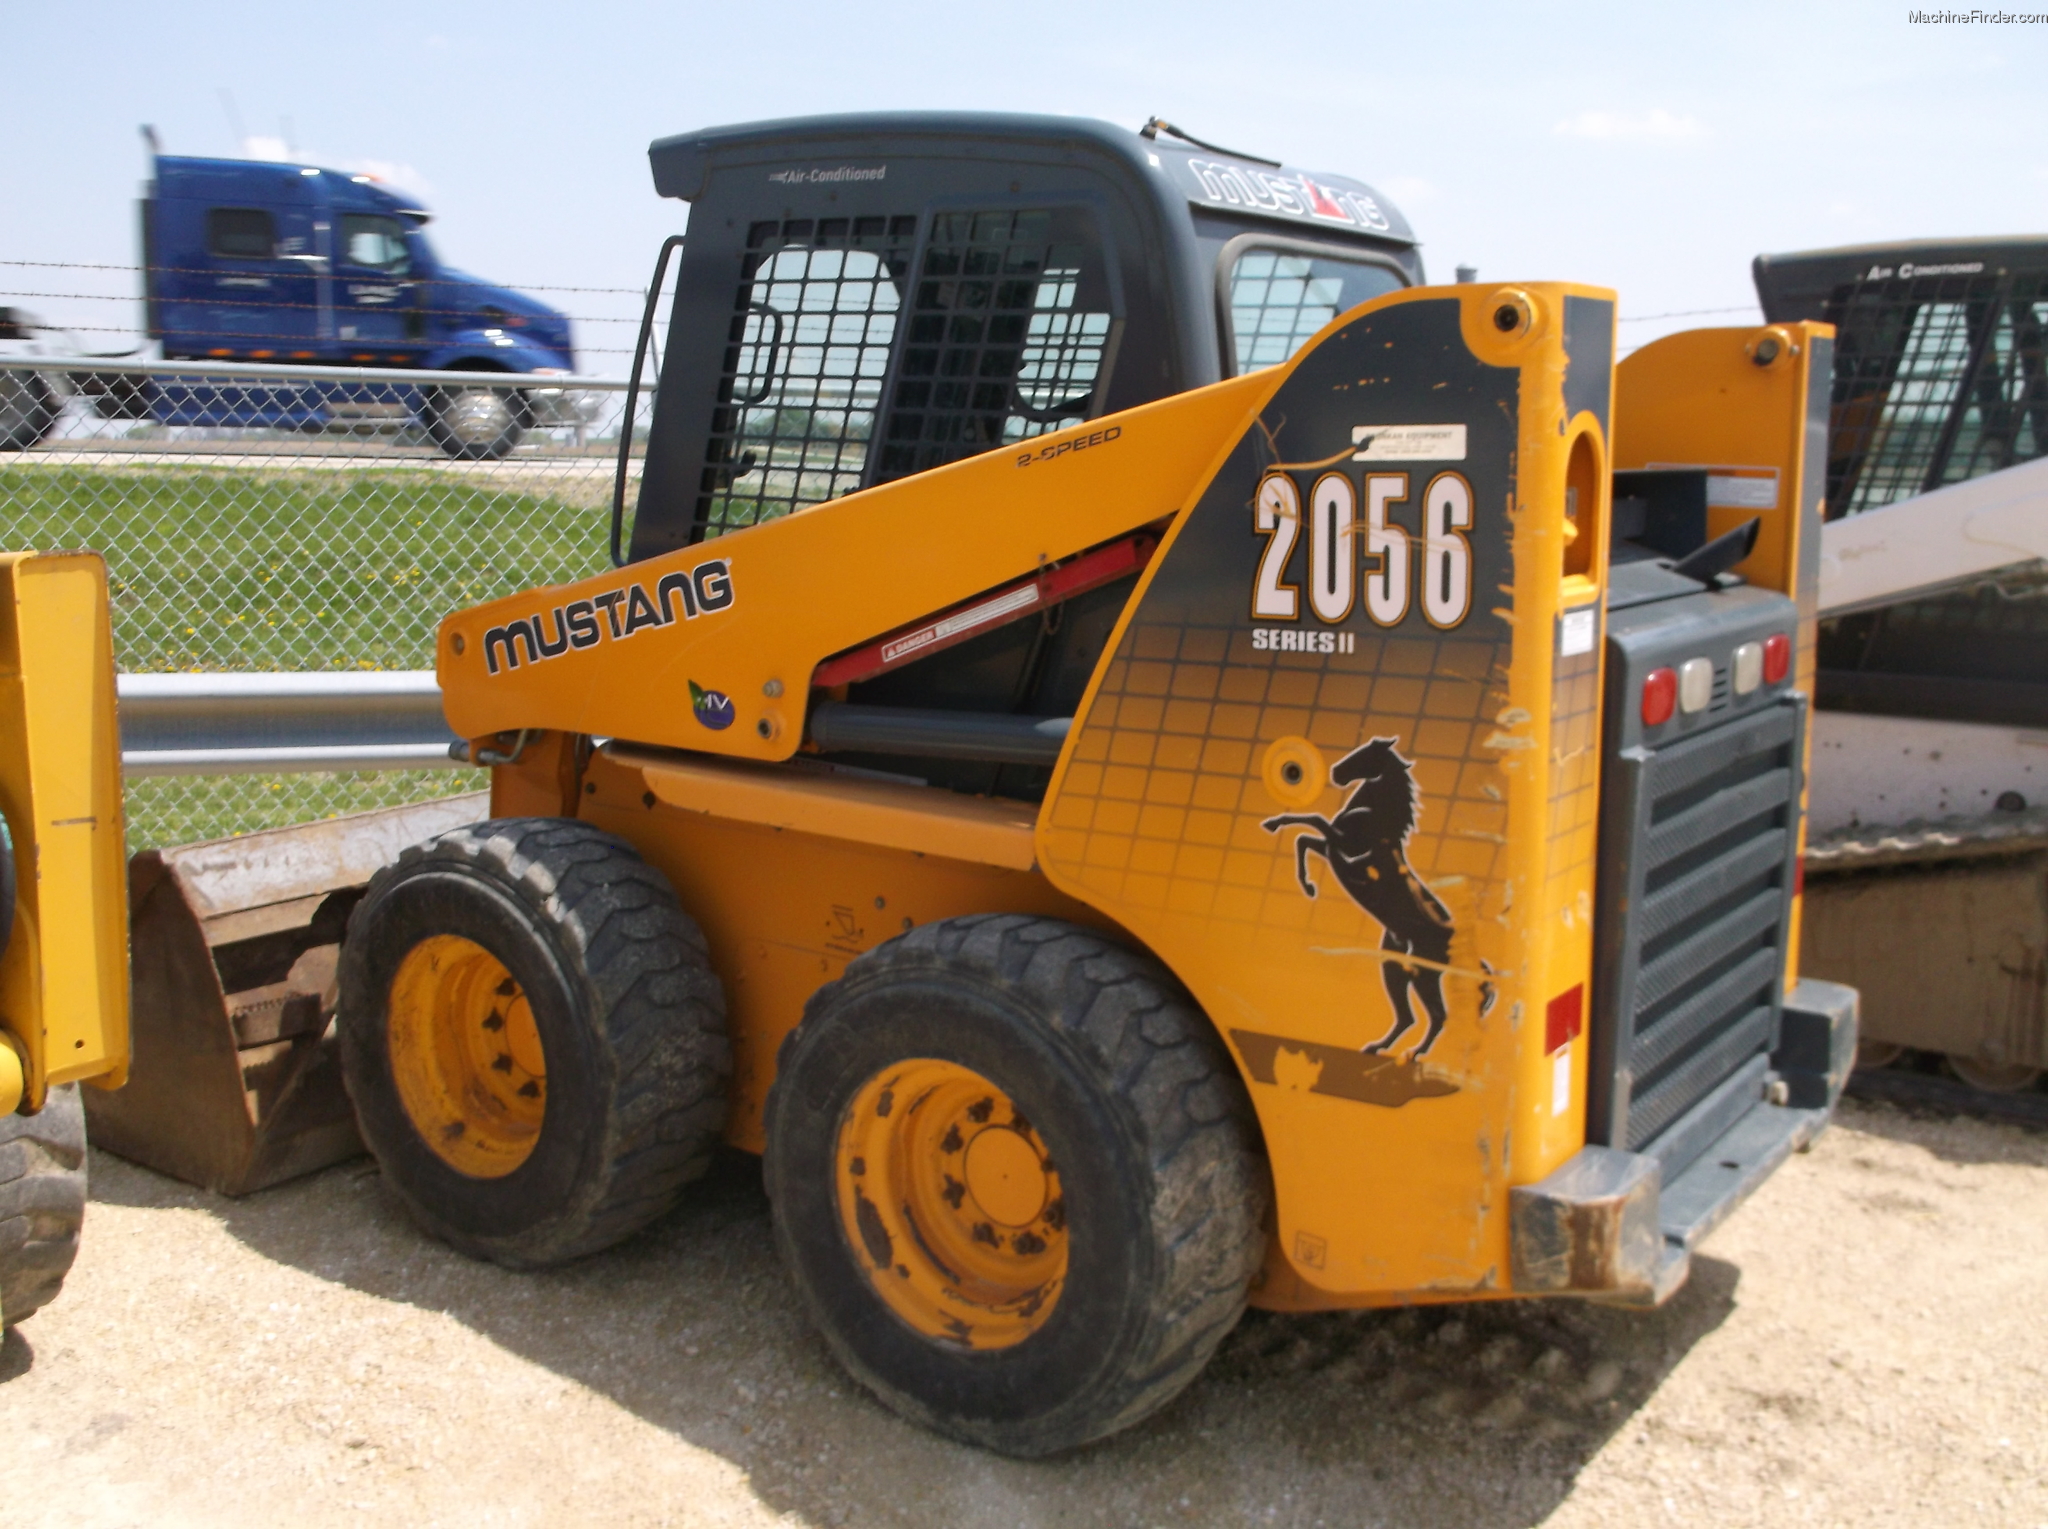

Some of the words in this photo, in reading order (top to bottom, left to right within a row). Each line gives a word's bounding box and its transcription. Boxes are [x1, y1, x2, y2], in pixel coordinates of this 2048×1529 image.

[785, 165, 887, 184] Air-Conditioned
[1016, 426, 1122, 469] 2-SPEED
[1252, 470, 1475, 629] 2056
[484, 559, 735, 676] MUSTANG
[1252, 628, 1335, 653] SERIES
